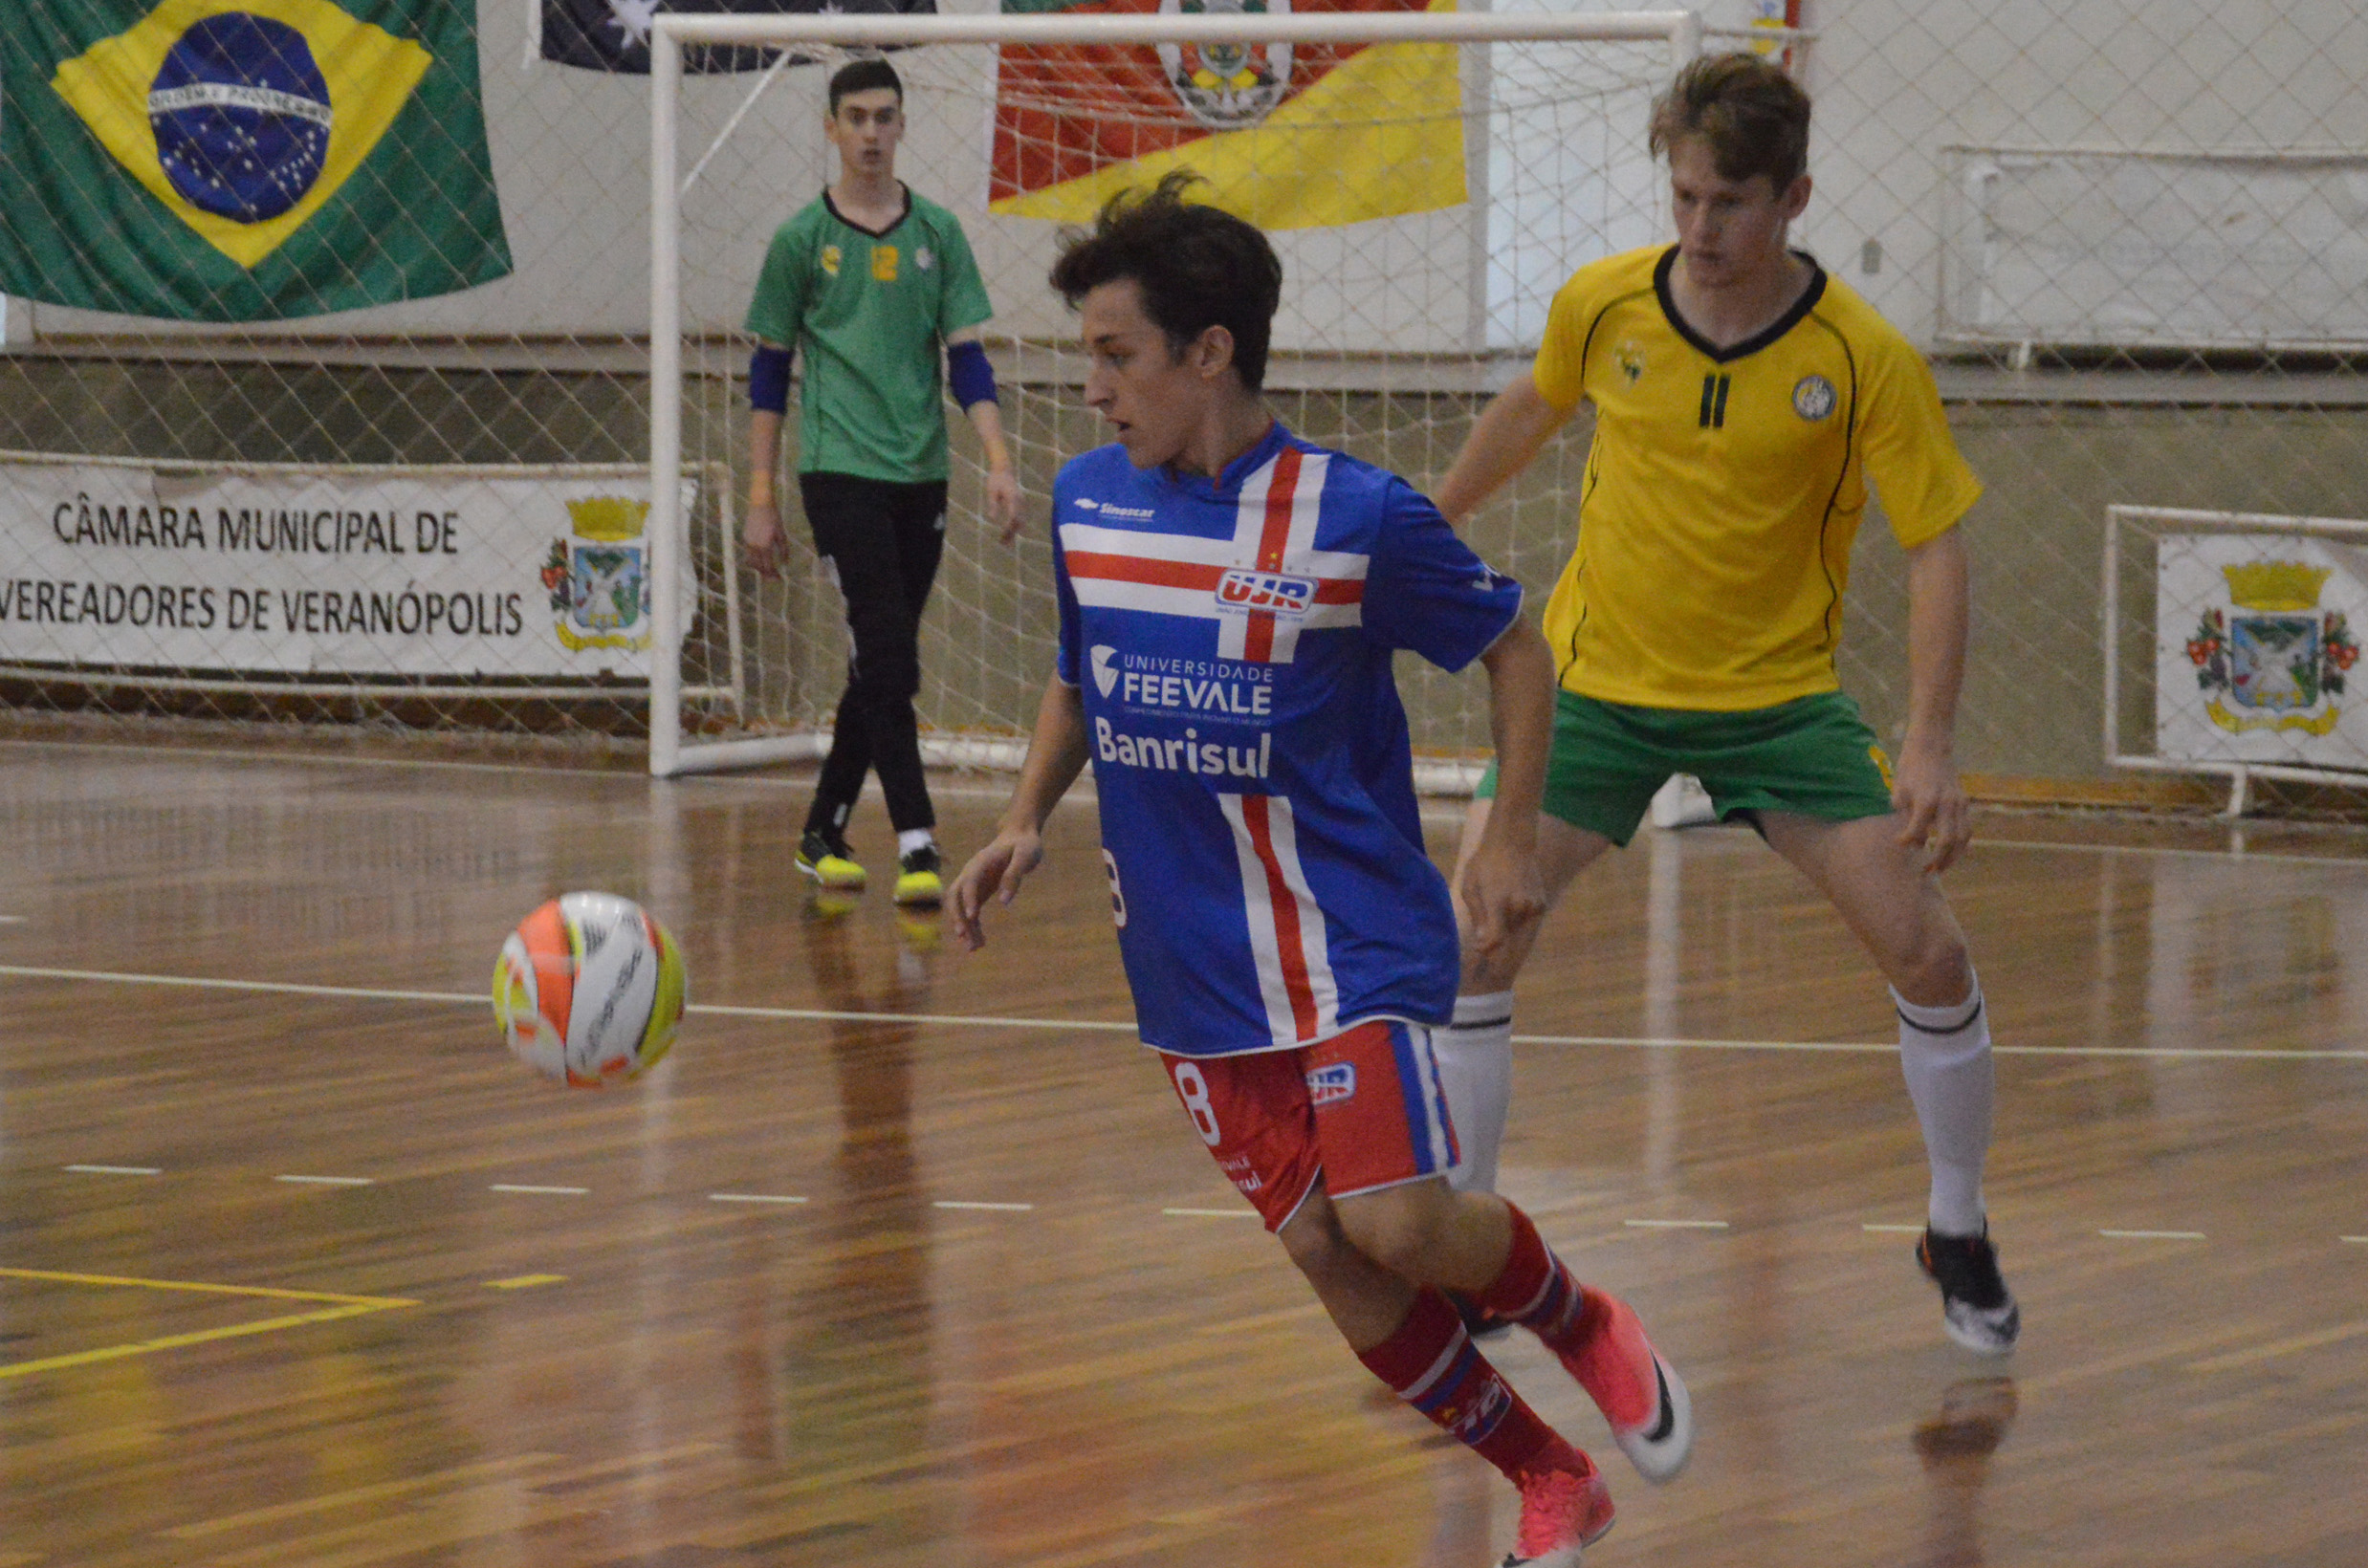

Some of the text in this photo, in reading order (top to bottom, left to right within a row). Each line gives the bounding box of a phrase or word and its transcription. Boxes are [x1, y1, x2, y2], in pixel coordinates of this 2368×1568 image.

[871, 246, 898, 280] 12
[1699, 374, 1730, 428] 11
[54, 491, 459, 555] CÂMARA MUNICIPAL DE
[228, 587, 270, 632] DE
[283, 580, 523, 638] VERANÓPOLIS
[1124, 654, 1273, 683] UNIVERSIDADE
[1124, 672, 1272, 715] FEEVALE
[1095, 716, 1271, 779] Banrisul
[1174, 1062, 1220, 1146] 8
